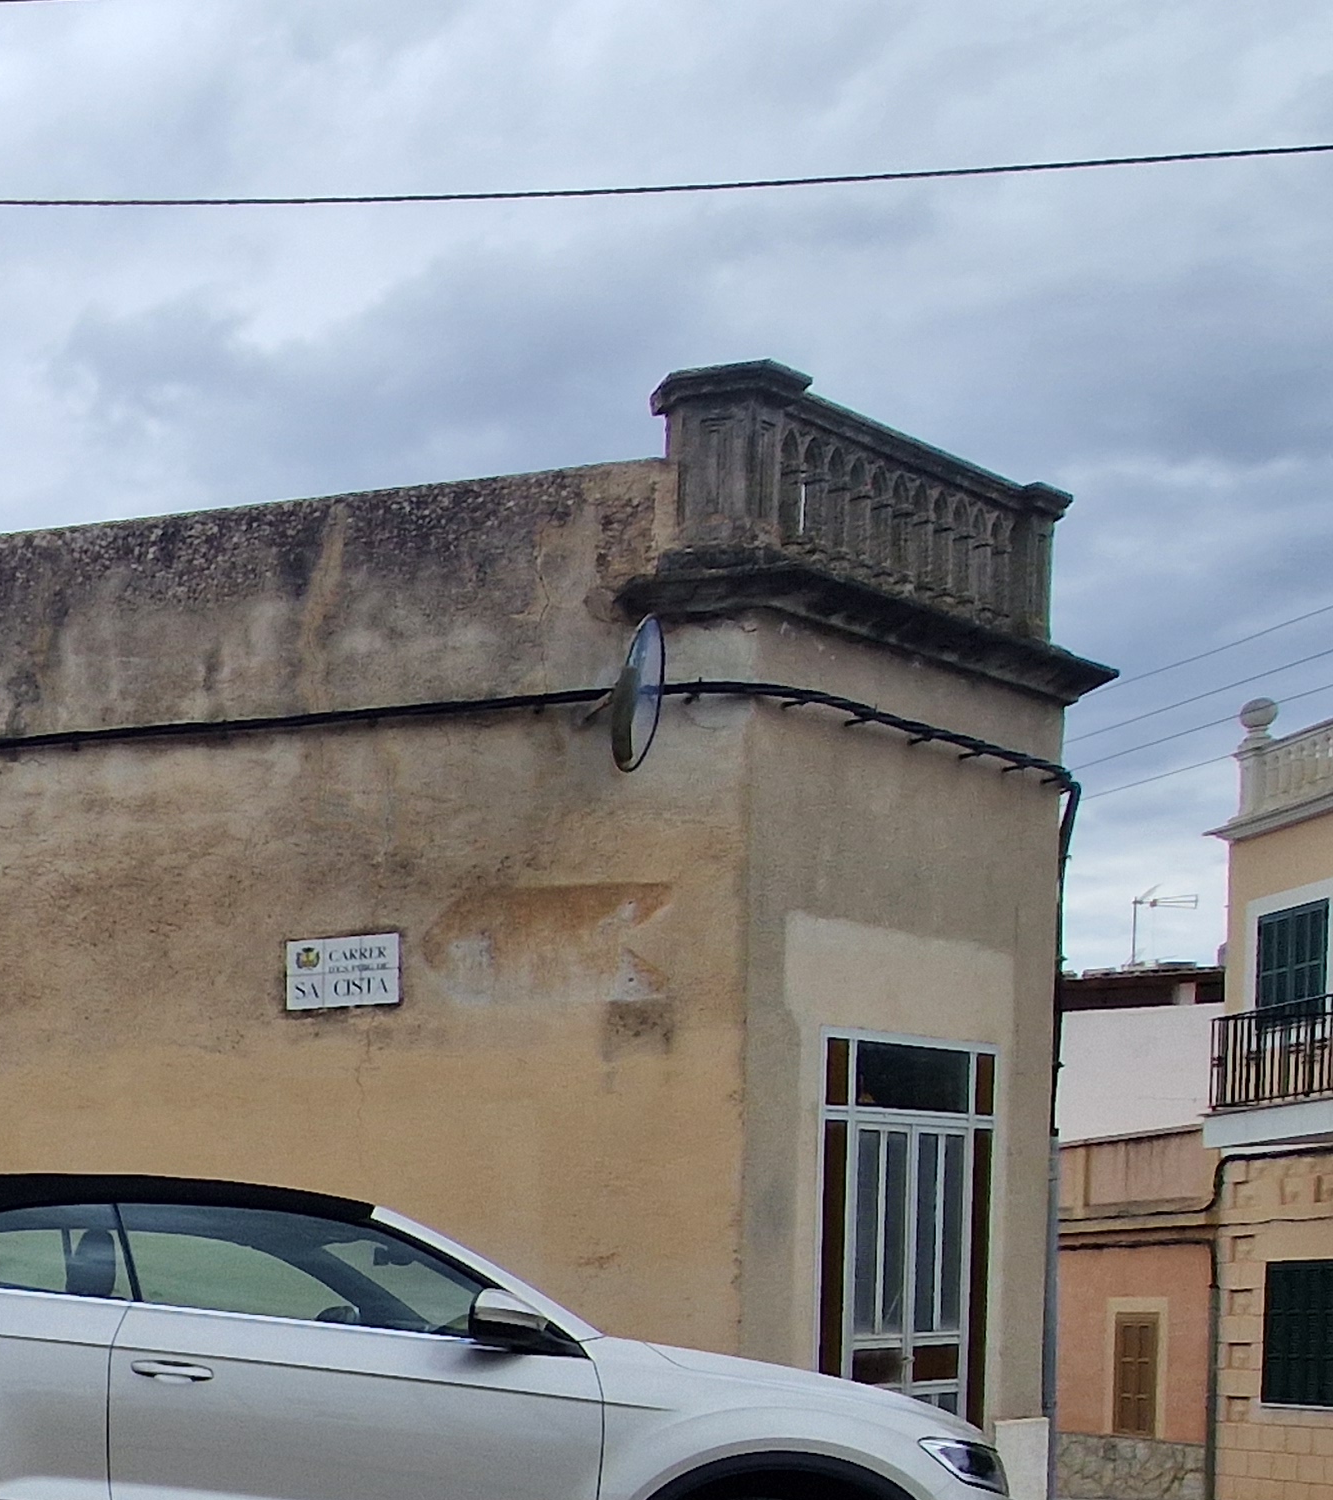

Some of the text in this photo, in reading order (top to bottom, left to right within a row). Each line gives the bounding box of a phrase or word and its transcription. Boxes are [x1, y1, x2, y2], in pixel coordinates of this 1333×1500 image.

[328, 946, 387, 962] CARRER
[294, 977, 389, 1000] SA CISTA
